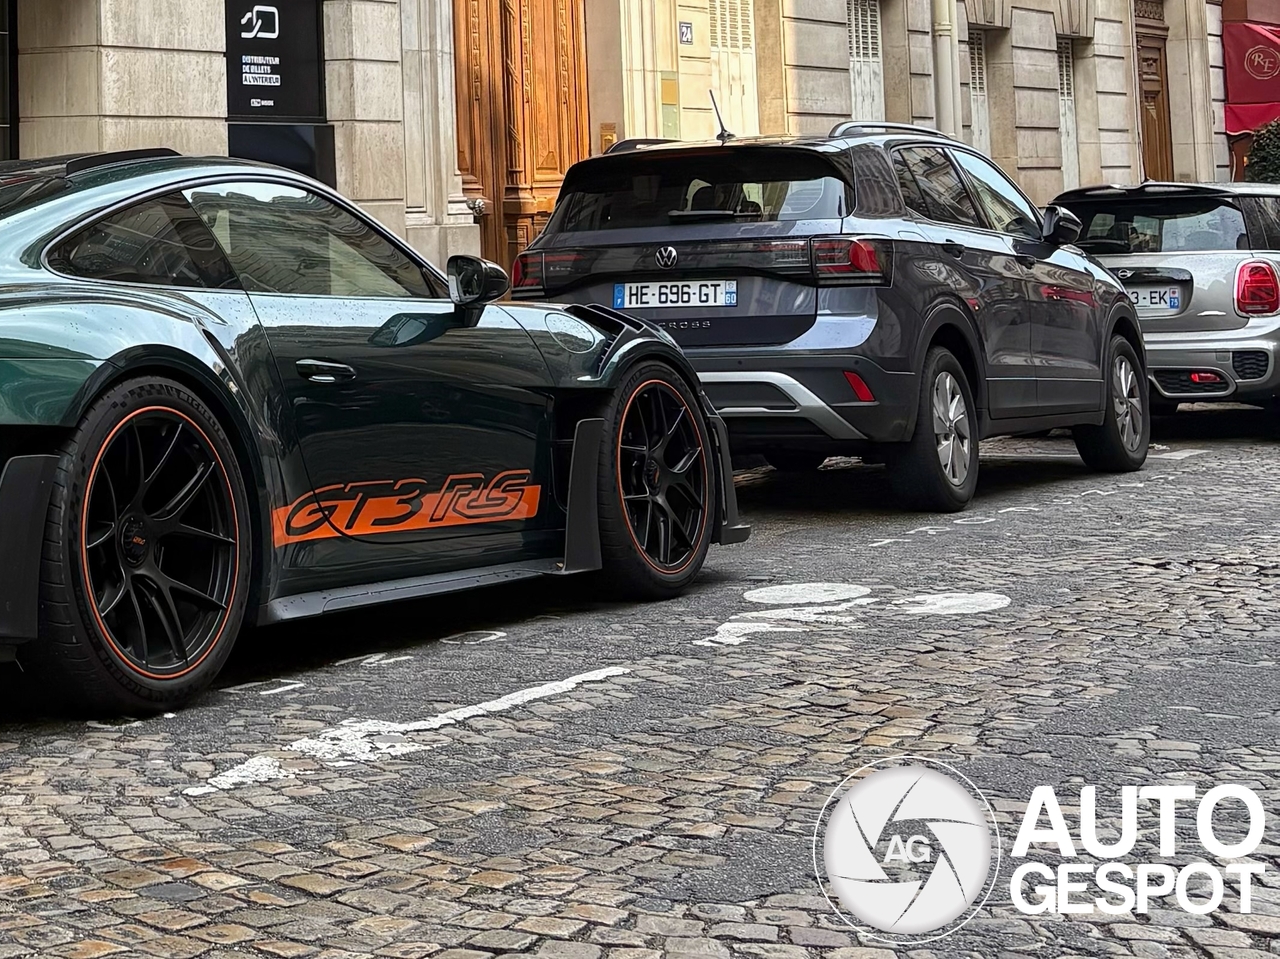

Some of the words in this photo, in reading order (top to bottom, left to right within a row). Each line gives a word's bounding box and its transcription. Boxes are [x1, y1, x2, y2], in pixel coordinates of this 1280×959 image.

[628, 283, 721, 305] HE-696-GT
[725, 293, 737, 304] 60
[1127, 290, 1168, 305] 3-EK
